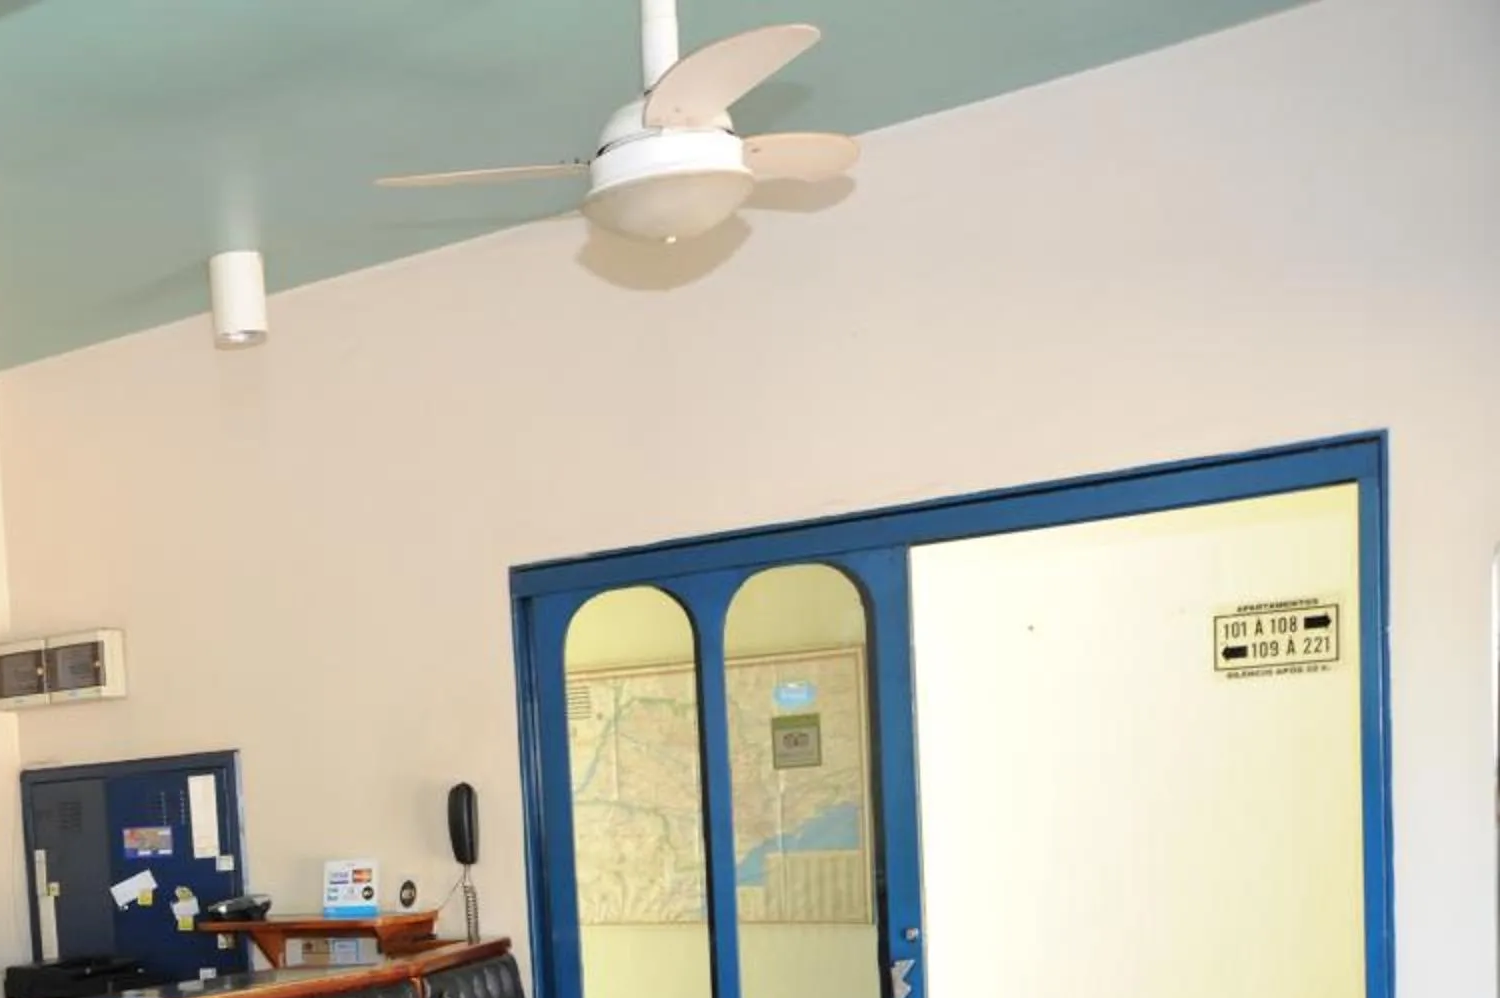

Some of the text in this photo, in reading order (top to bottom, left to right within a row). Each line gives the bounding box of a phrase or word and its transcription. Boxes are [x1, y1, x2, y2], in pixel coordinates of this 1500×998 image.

[1224, 621, 1247, 640] 101
[1270, 616, 1298, 634] 108
[1251, 640, 1279, 659] 109
[1303, 636, 1330, 655] 221
